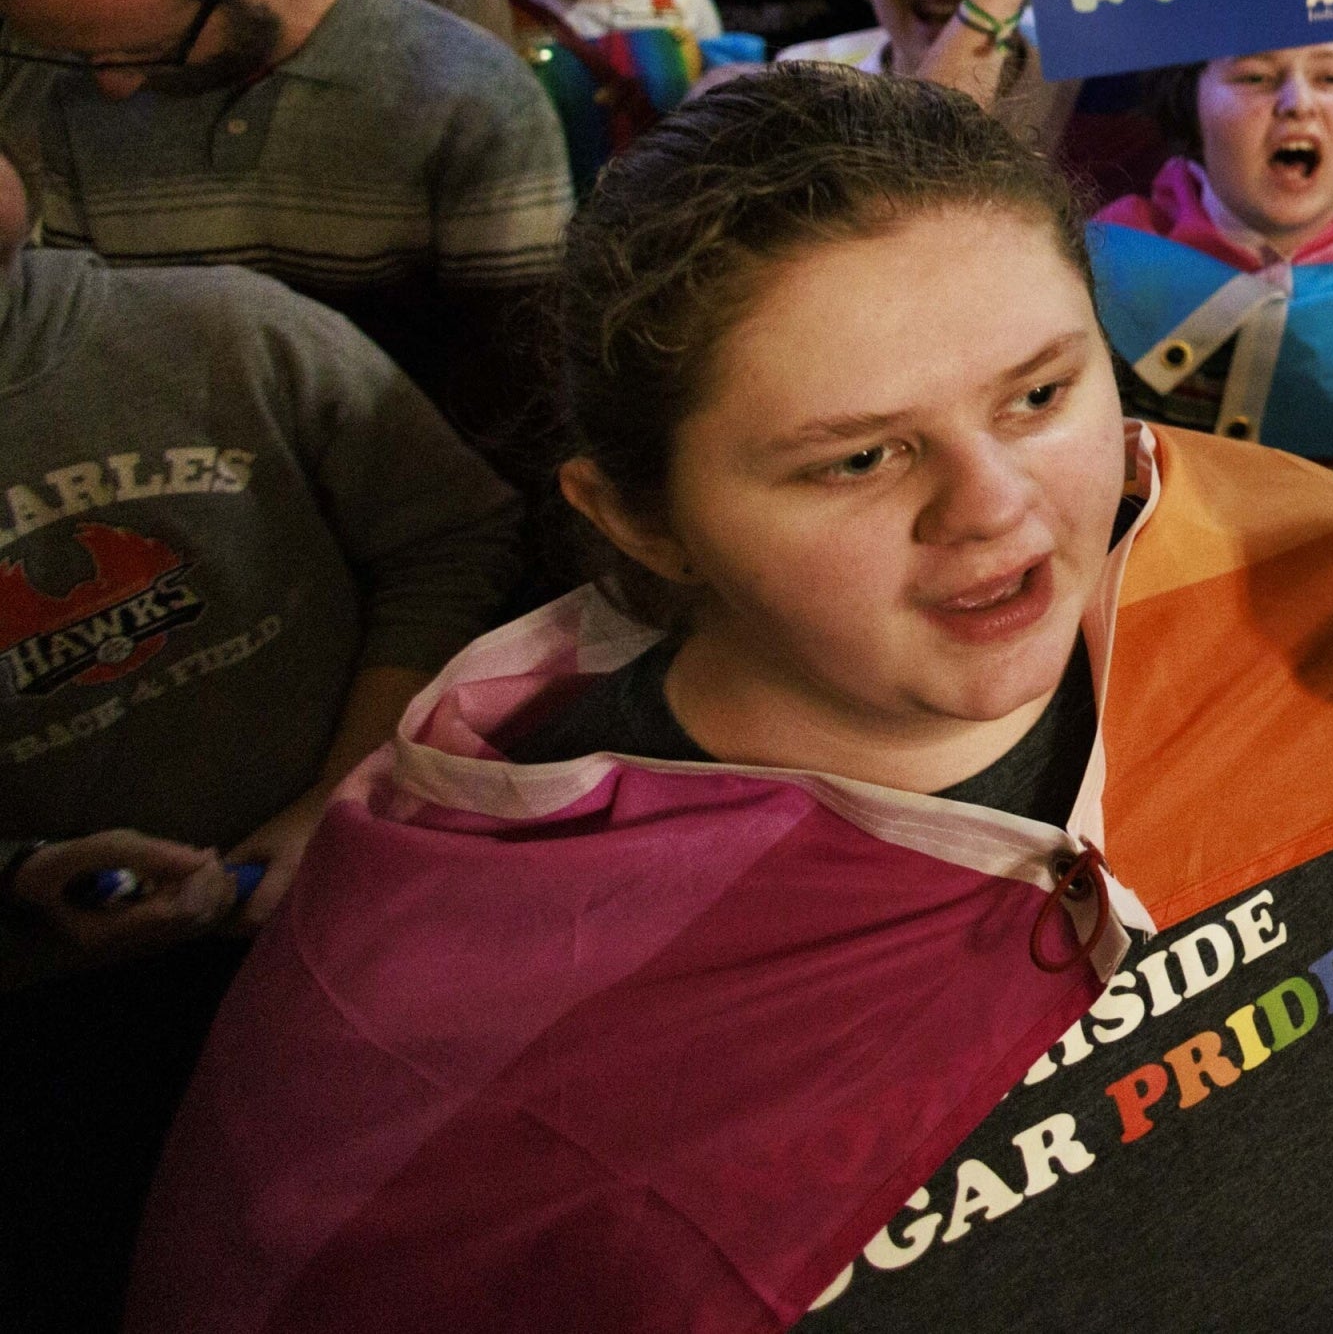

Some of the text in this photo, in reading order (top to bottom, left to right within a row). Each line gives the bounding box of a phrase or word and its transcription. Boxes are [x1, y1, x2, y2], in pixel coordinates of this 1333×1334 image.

[0, 446, 258, 546] ARLES
[15, 576, 200, 688] HAWKS
[168, 614, 283, 685] FIELD
